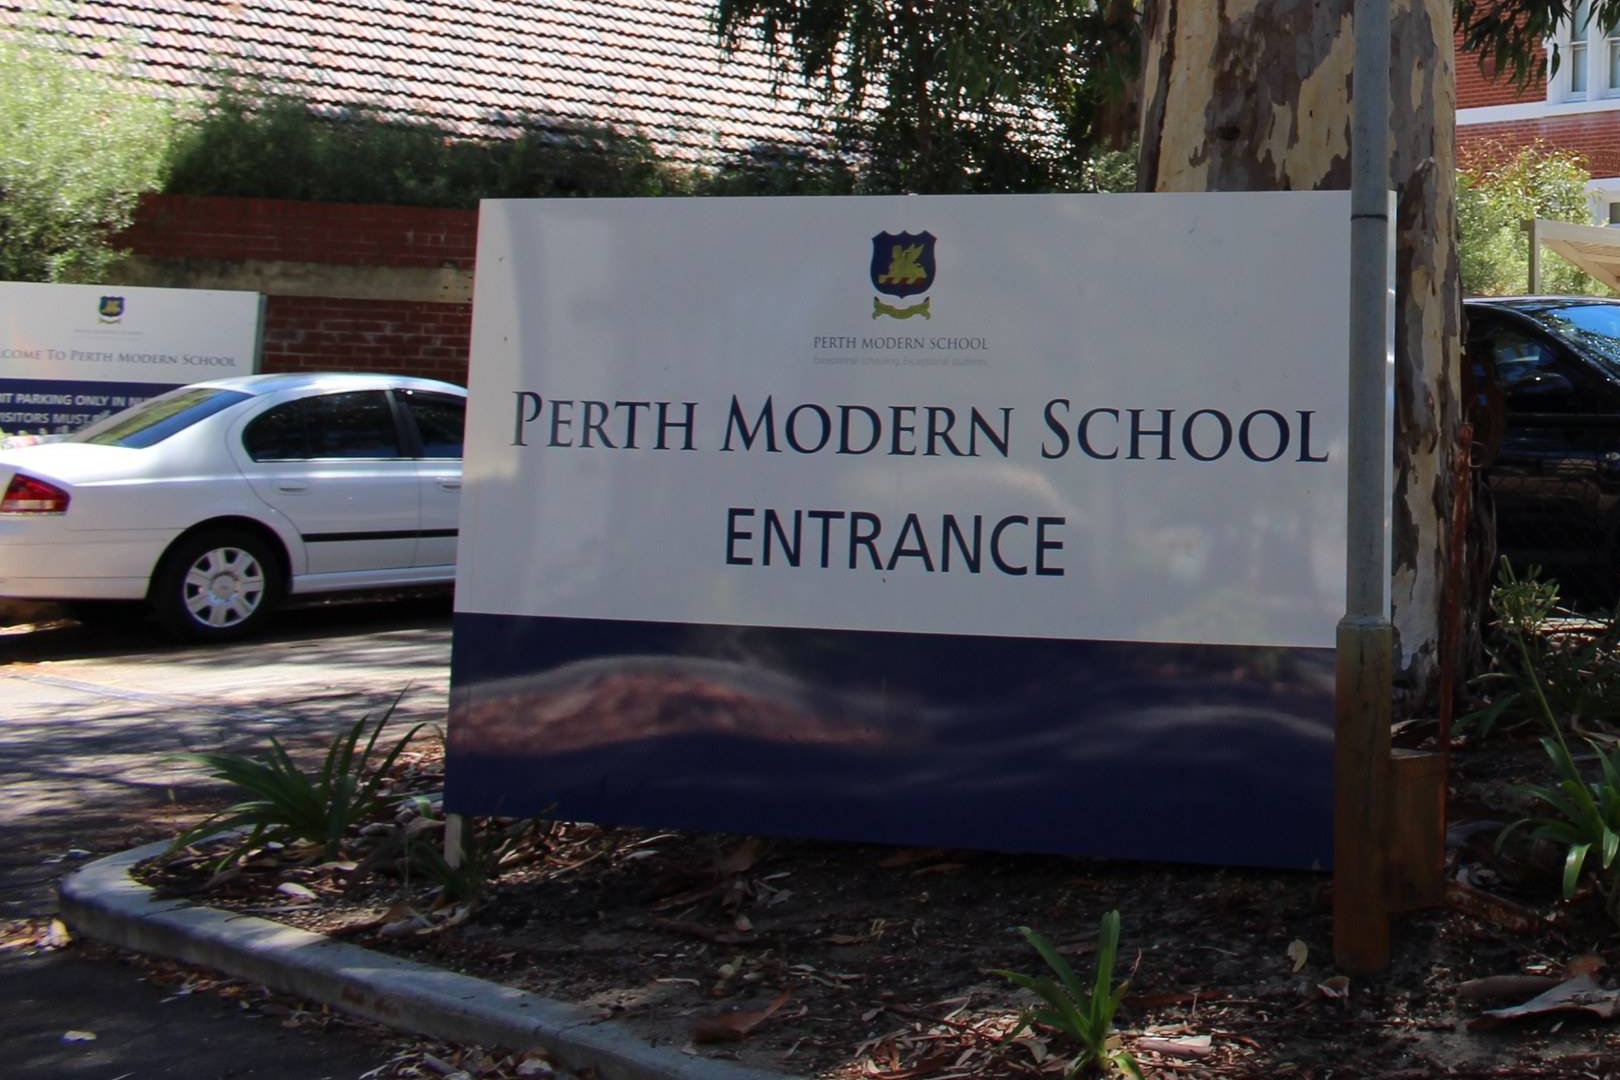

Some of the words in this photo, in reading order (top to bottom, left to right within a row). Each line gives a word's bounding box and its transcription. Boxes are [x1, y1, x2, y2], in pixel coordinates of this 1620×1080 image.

[813, 336, 857, 350] PERTH
[861, 336, 925, 350] MODERN
[929, 337, 989, 351] SCHOOL
[0, 348, 41, 361] COME
[70, 350, 113, 363] PERTH
[118, 352, 178, 365] MODERN
[182, 354, 236, 368] SCHOOL
[15, 393, 73, 406] PARKING
[74, 395, 110, 406] ONLY
[111, 396, 127, 407] IN
[52, 413, 91, 425] MUST
[511, 391, 699, 452] PERTH
[719, 394, 1014, 458] MODERN
[1041, 399, 1331, 464] SCHOOL
[724, 508, 1067, 577] ENTRANCE
